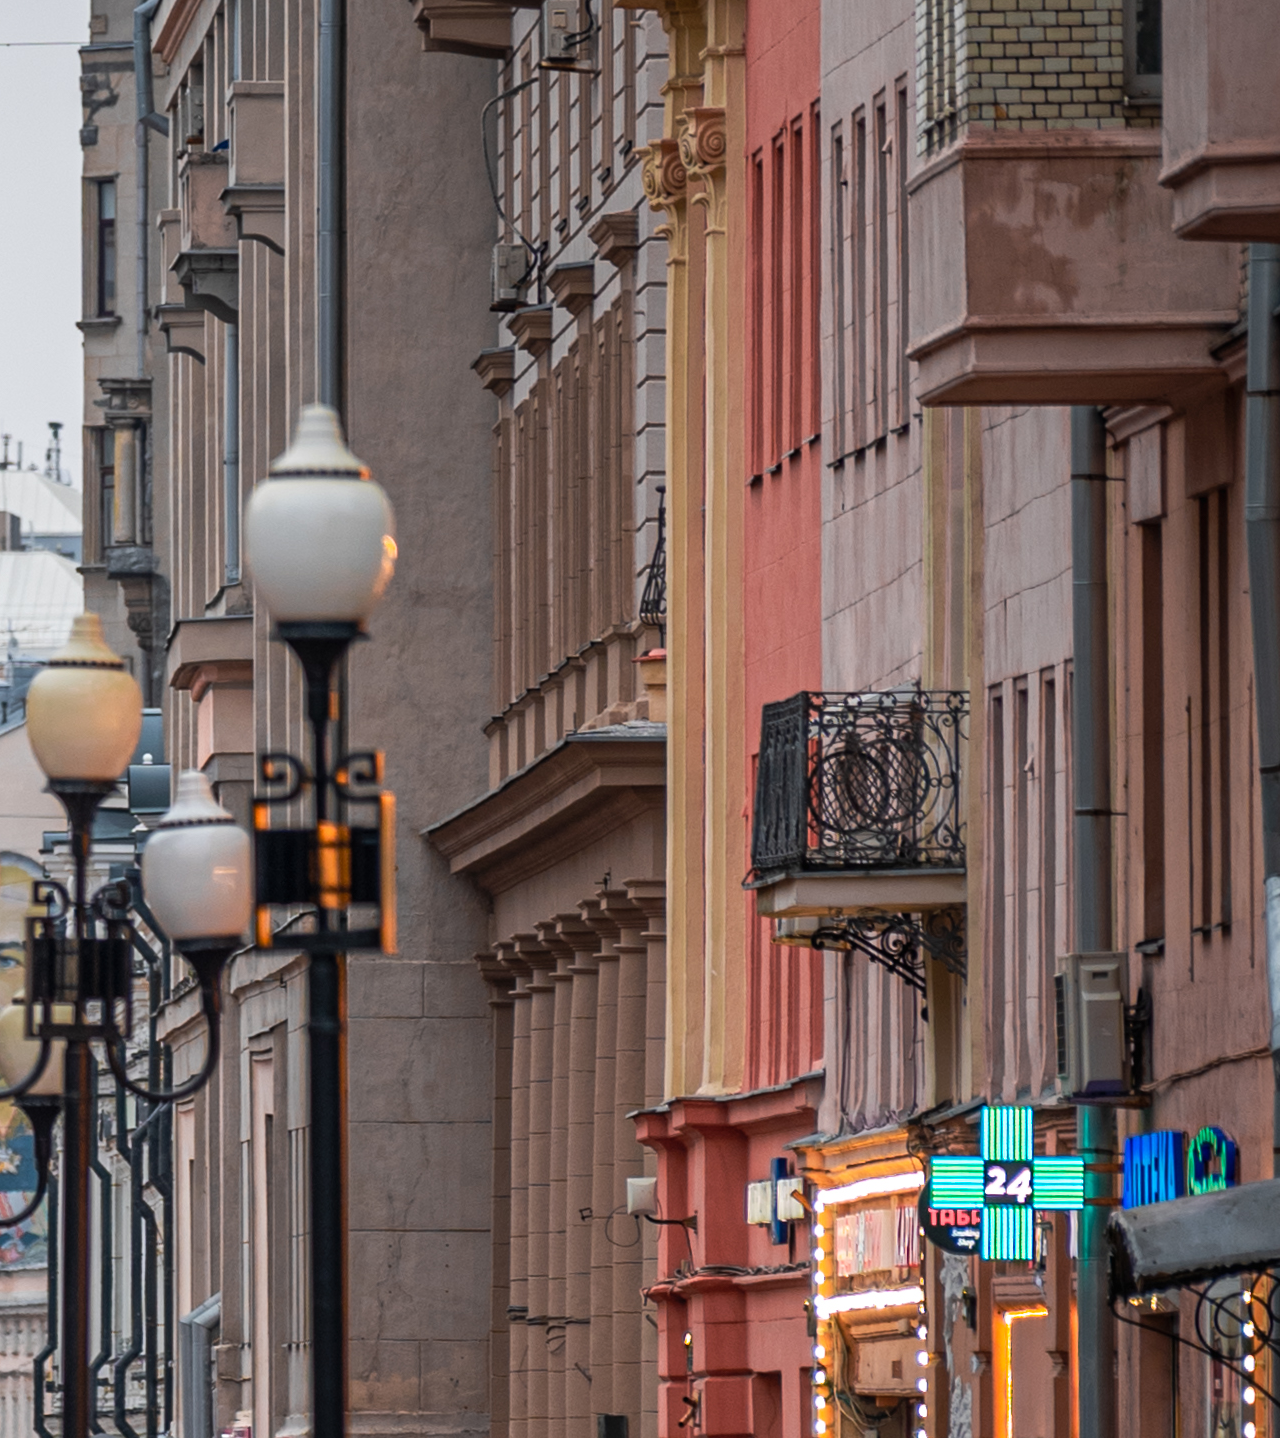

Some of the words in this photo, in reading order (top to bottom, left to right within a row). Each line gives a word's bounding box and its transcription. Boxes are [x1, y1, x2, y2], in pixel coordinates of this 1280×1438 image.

[985, 1166, 1032, 1203] 24
[1122, 1130, 1175, 1210] АПТЕКА
[928, 1208, 980, 1226] ТАБА
